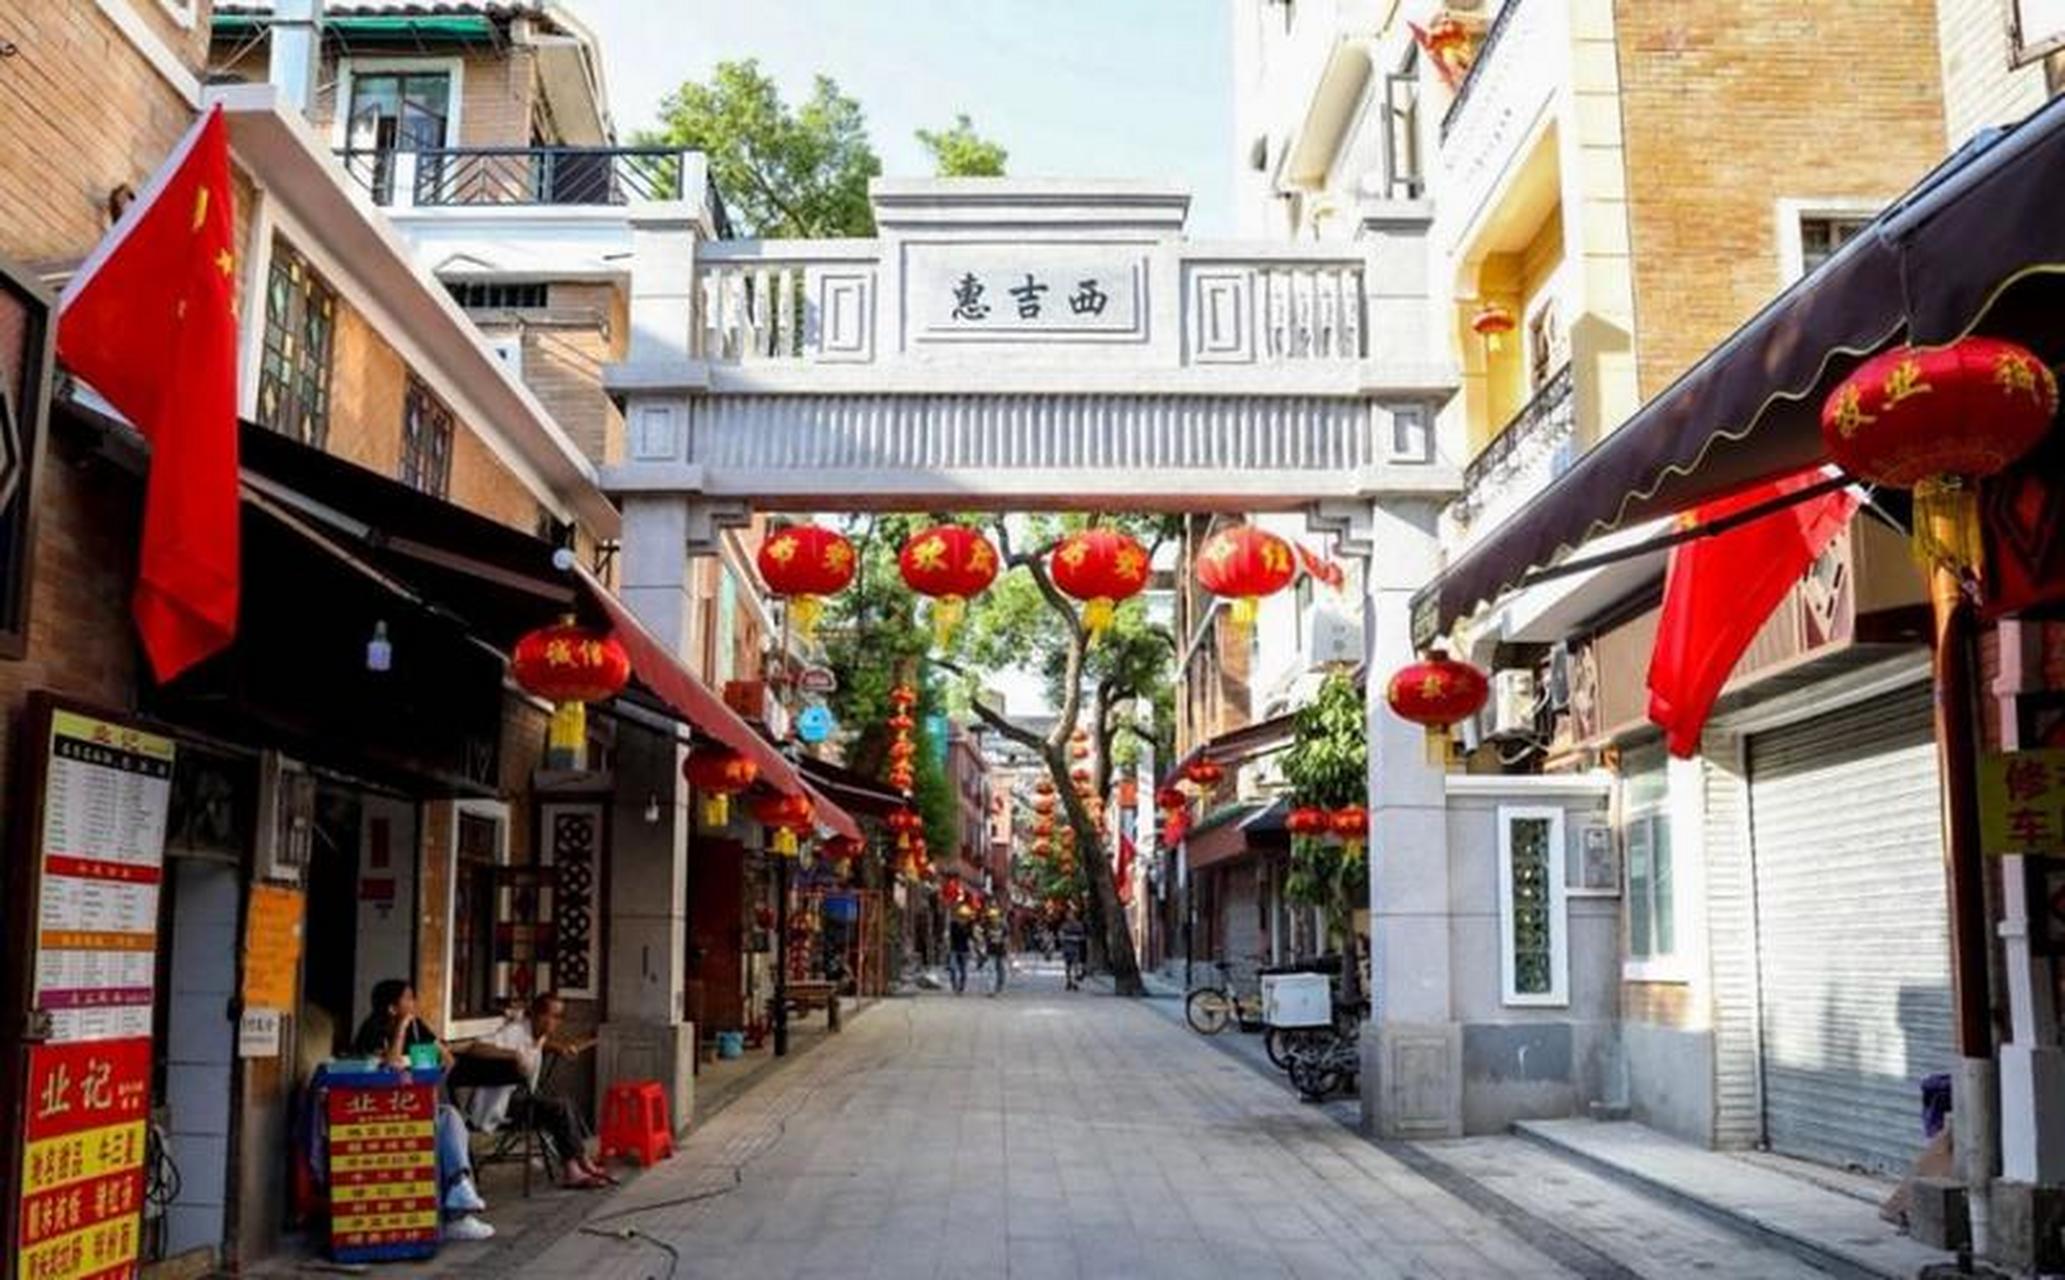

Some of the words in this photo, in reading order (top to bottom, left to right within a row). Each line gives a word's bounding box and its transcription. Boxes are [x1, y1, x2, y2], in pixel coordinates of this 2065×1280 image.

[952, 272, 1108, 320] 惠吉西
[545, 637, 604, 668] 诚信
[2005, 757, 2054, 846] 修车
[36, 1056, 114, 1119] 业记
[345, 1089, 422, 1115] 业记
